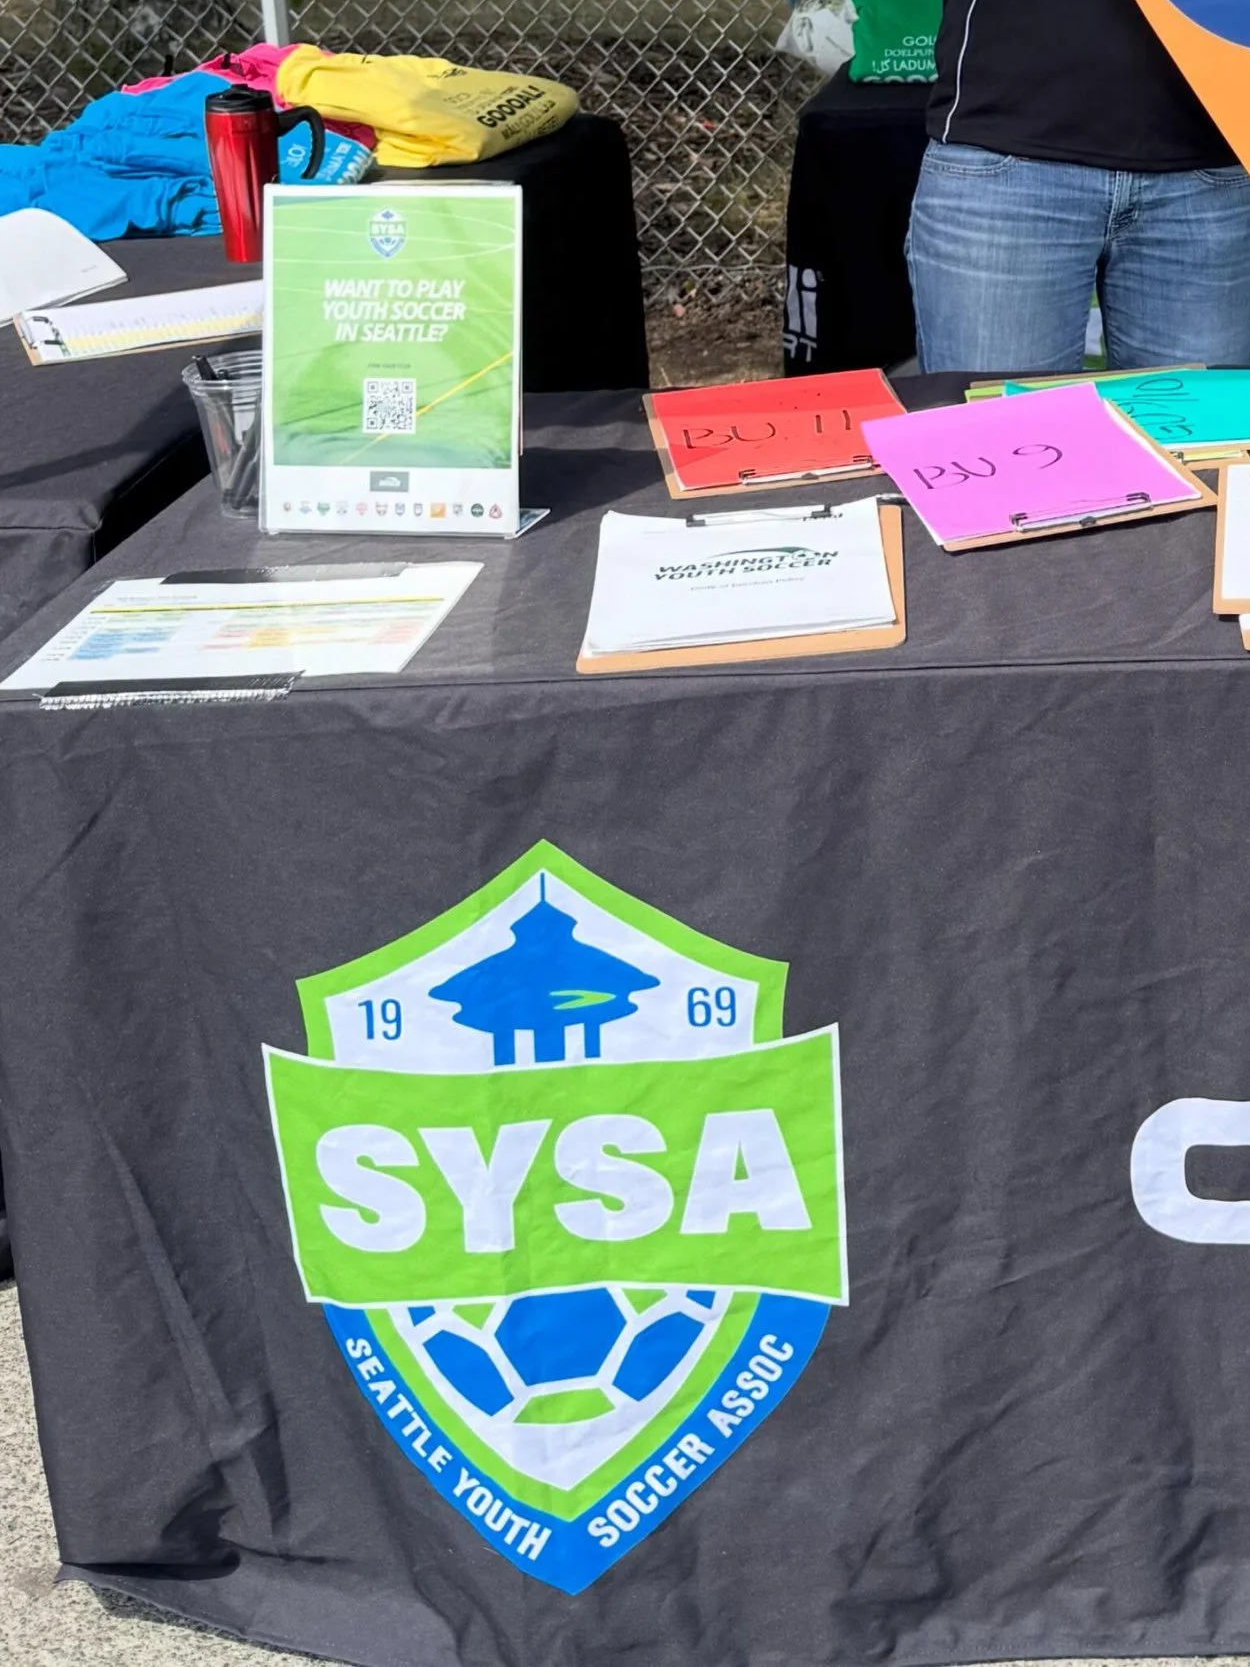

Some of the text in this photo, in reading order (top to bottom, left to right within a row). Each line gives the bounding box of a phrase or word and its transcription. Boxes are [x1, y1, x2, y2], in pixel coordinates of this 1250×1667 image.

[476, 84, 546, 128] GOOOAL!
[371, 223, 405, 235] SYSA
[323, 279, 467, 299] WANT TO PLAY
[322, 301, 467, 320] YOUTH SOCCER
[335, 323, 449, 343] IN SEATTLE?
[683, 409, 852, 450] BU 11
[913, 443, 1063, 490] BU 9
[654, 558, 832, 582] YOUTH SOCCER
[357, 987, 739, 1041] 19 69
[315, 1108, 813, 1255] SYSA
[344, 1337, 552, 1562] SEATTLE YOUTH
[587, 1334, 794, 1548] SOCCER ASSOC
